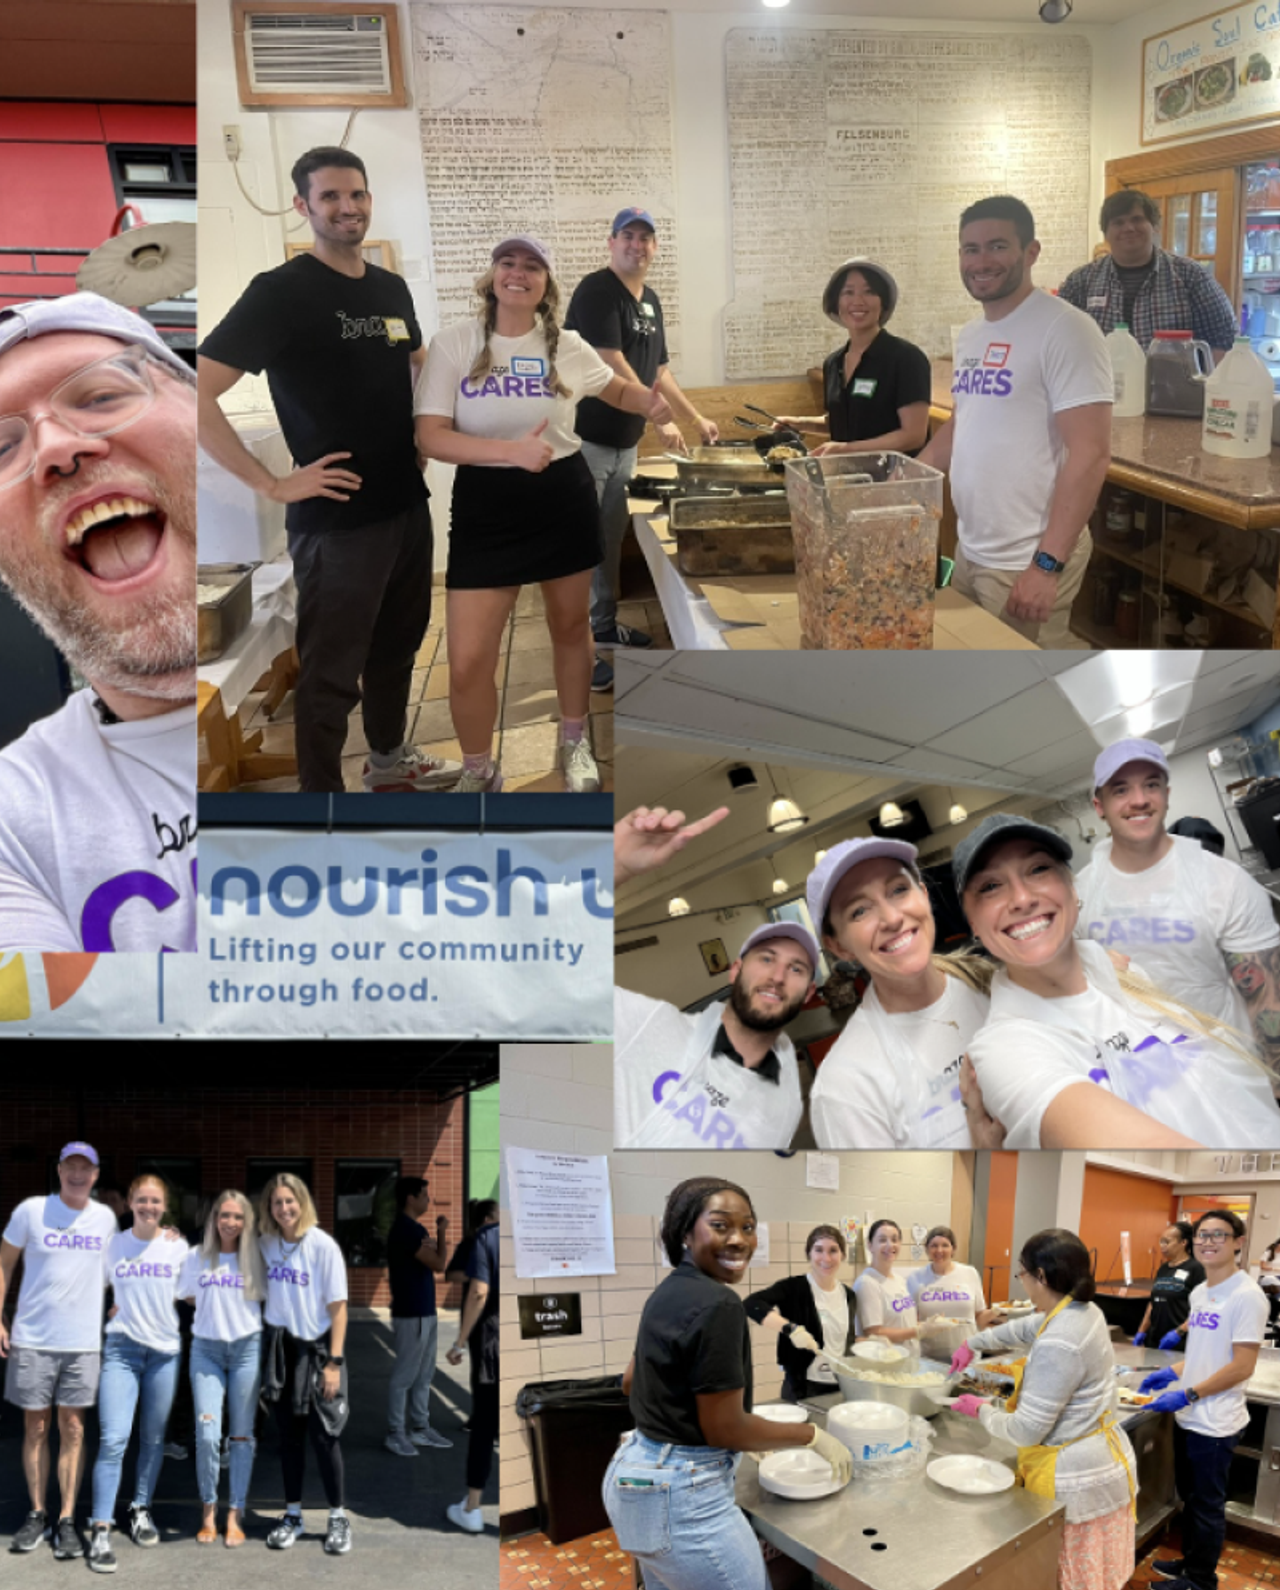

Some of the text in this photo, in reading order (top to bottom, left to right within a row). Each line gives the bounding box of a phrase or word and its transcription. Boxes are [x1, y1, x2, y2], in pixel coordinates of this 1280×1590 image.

[209, 848, 549, 918] nourish
[1089, 916, 1196, 945] CARES
[209, 937, 584, 965] Lifting our community
[209, 977, 439, 1006] through food.
[652, 1069, 751, 1149] CAR
[44, 1233, 103, 1251] CARES
[115, 1262, 172, 1278] CARES
[198, 1273, 246, 1288] CARE
[534, 1310, 568, 1323] trash
